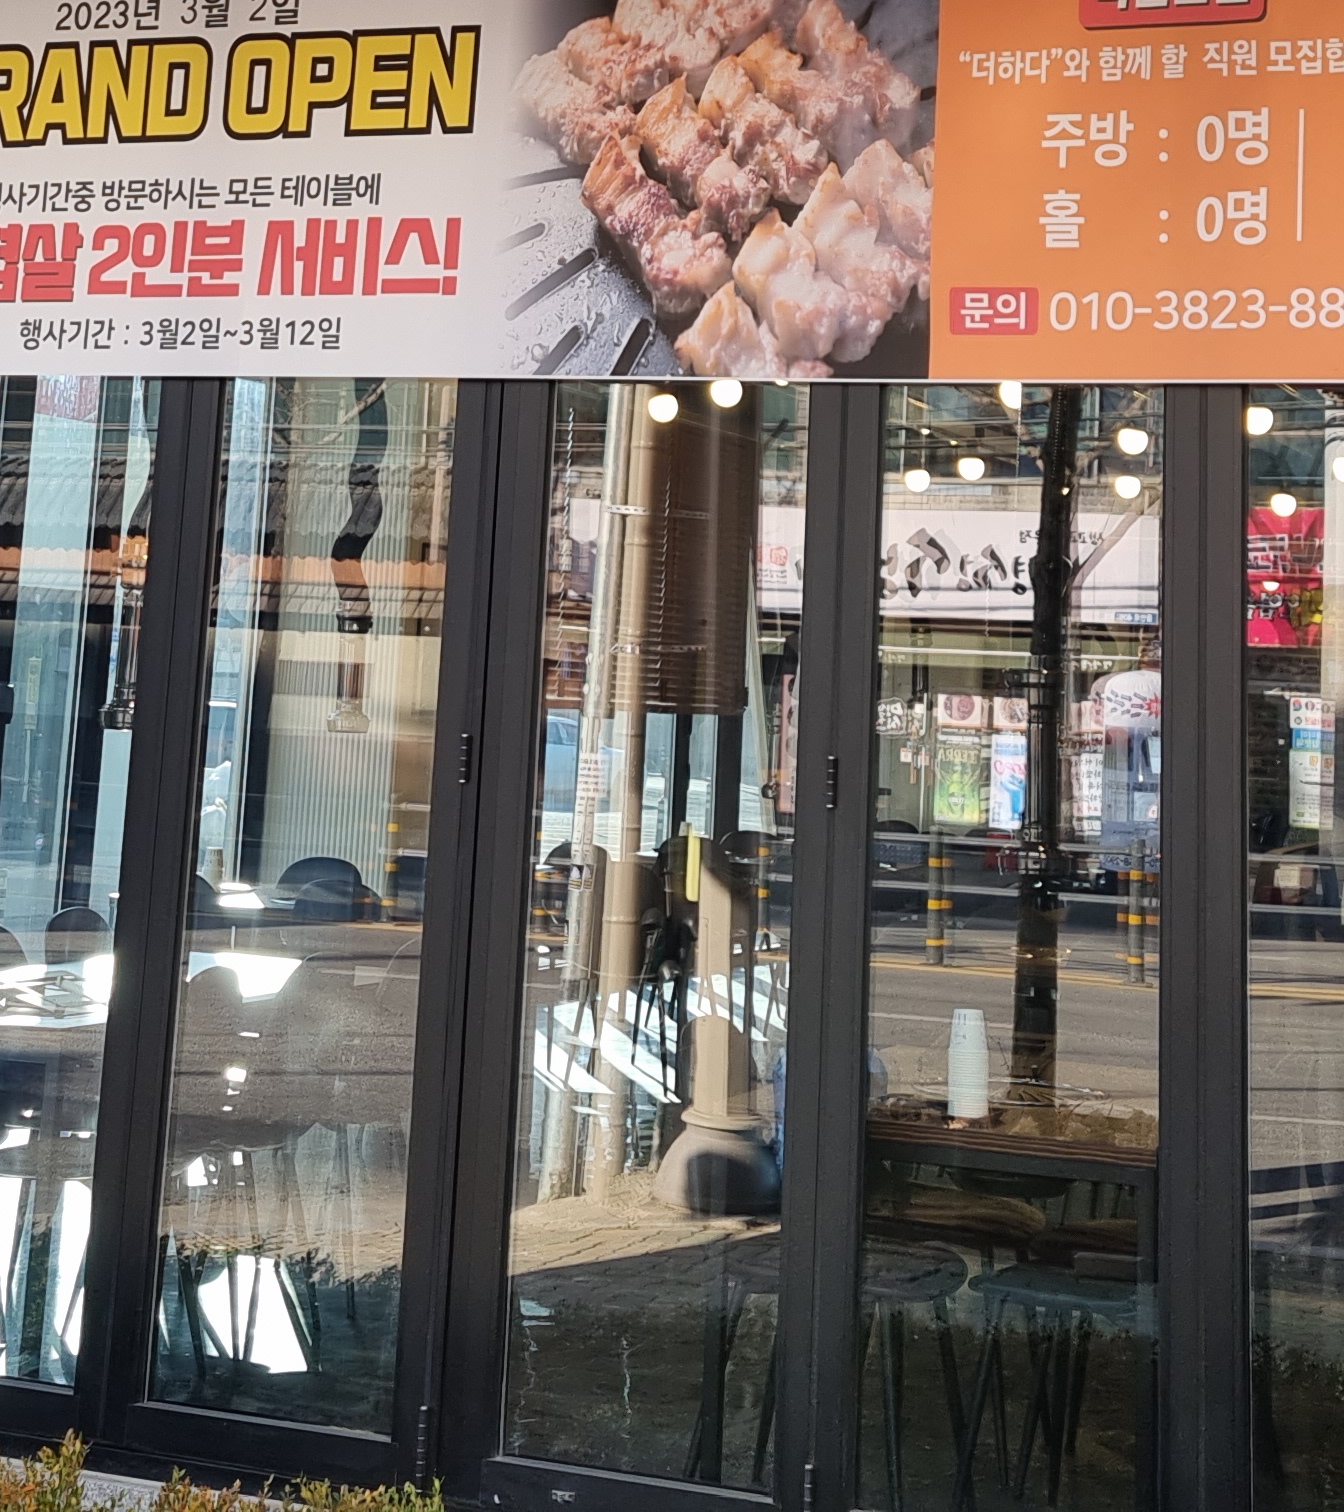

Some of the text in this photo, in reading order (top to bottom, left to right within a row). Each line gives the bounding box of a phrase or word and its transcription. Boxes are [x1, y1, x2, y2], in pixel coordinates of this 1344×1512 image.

[221, 24, 482, 138] OPEN
[1098, 45, 1153, 81] 함께
[1160, 43, 1188, 79] 할
[1202, 39, 1258, 76] 직원
[1041, 109, 1135, 169] 주방
[1196, 106, 1271, 165] 0명
[100, 176, 220, 211] 방문하시는
[223, 175, 276, 208] 모든
[279, 173, 382, 207] 테이블에
[1038, 190, 1086, 249] 홀
[1196, 186, 1269, 246] 0명
[87, 219, 246, 299] 2인분
[256, 216, 462, 297] 서비스!
[19, 319, 115, 351] 행사기간
[138, 316, 343, 350] 3월2일~3월12일
[960, 291, 1027, 330] 문의
